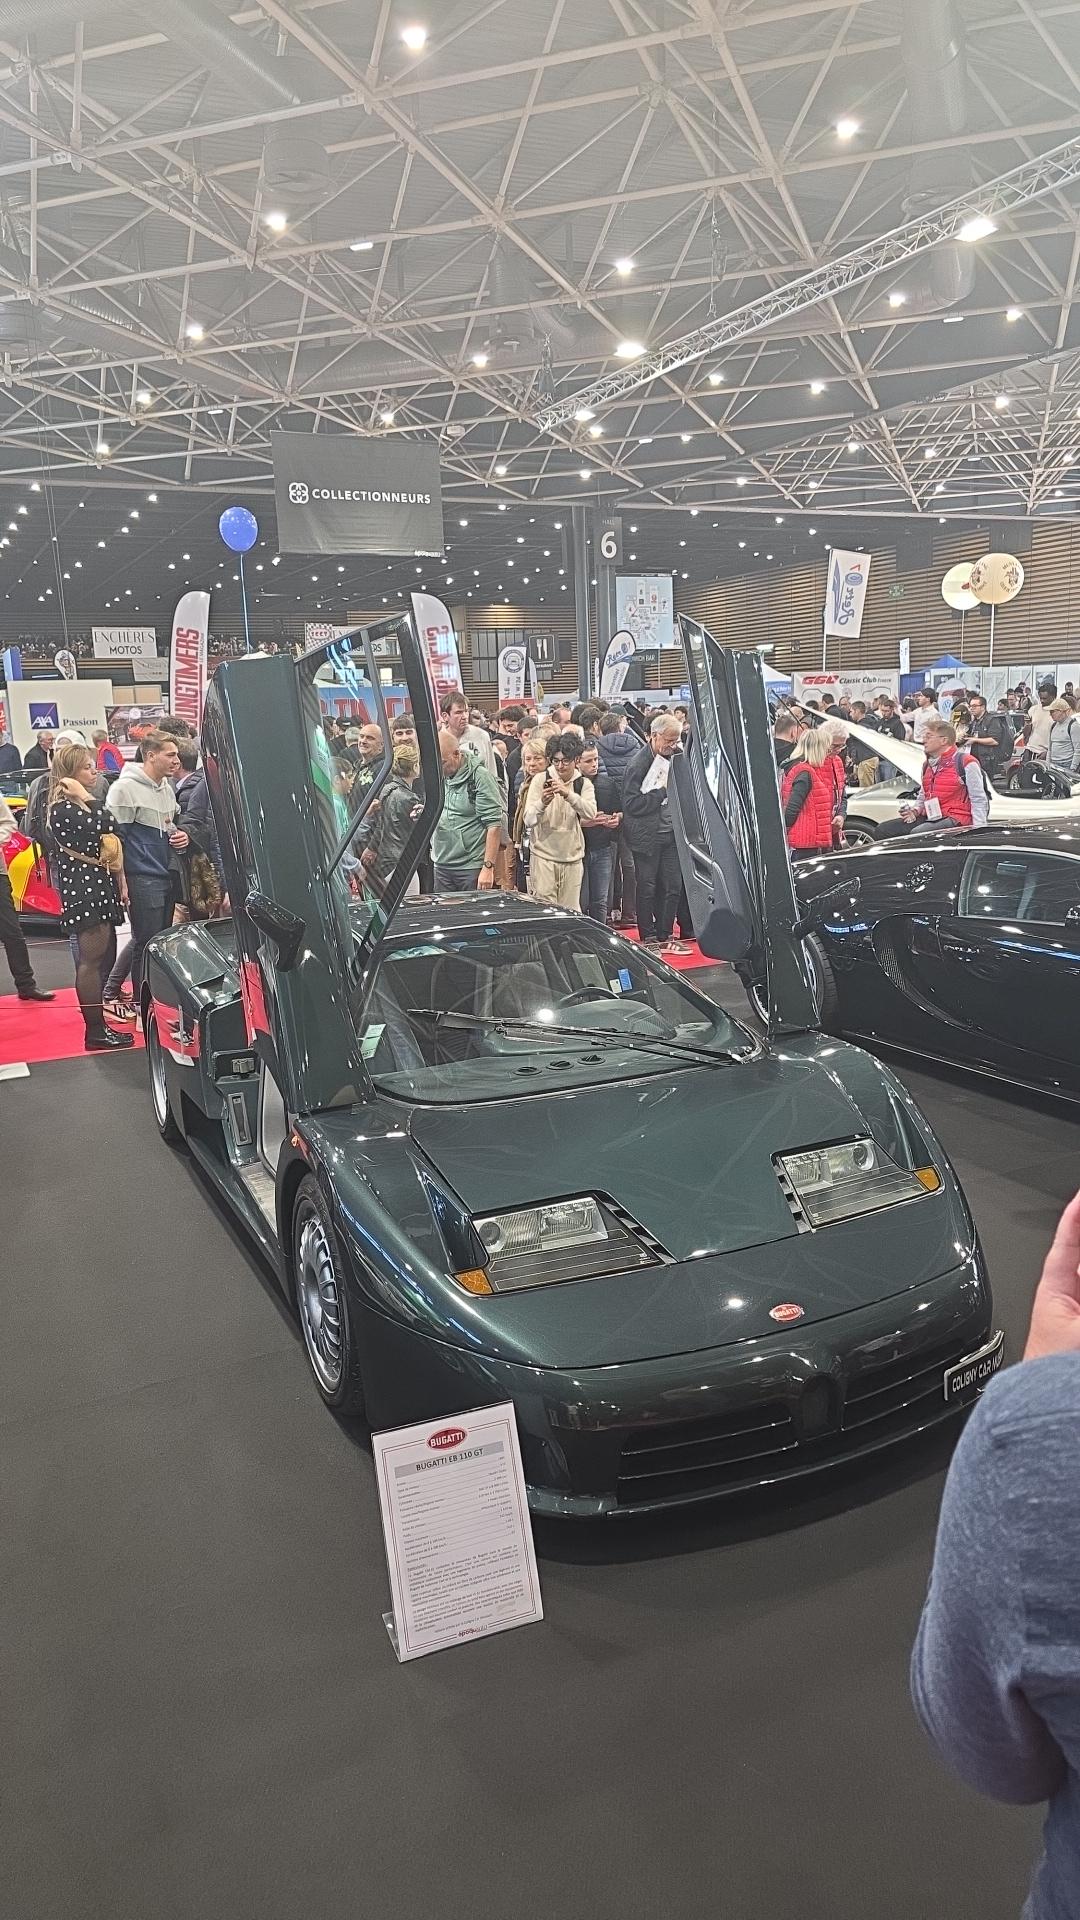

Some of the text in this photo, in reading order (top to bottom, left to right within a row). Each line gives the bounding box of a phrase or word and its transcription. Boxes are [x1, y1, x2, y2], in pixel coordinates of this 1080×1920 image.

[312, 489, 431, 504] COLLECTIONNEURS
[601, 531, 617, 559] 6
[110, 645, 142, 655] MOTOS
[32, 716, 55, 728] AXA
[63, 717, 98, 726] Passion
[952, 1366, 978, 1392] COLIGNY
[978, 1360, 991, 1379] CAR
[430, 1431, 463, 1447] BUGATTI
[416, 1448, 484, 1471] BUGATTI EB 110 GT
